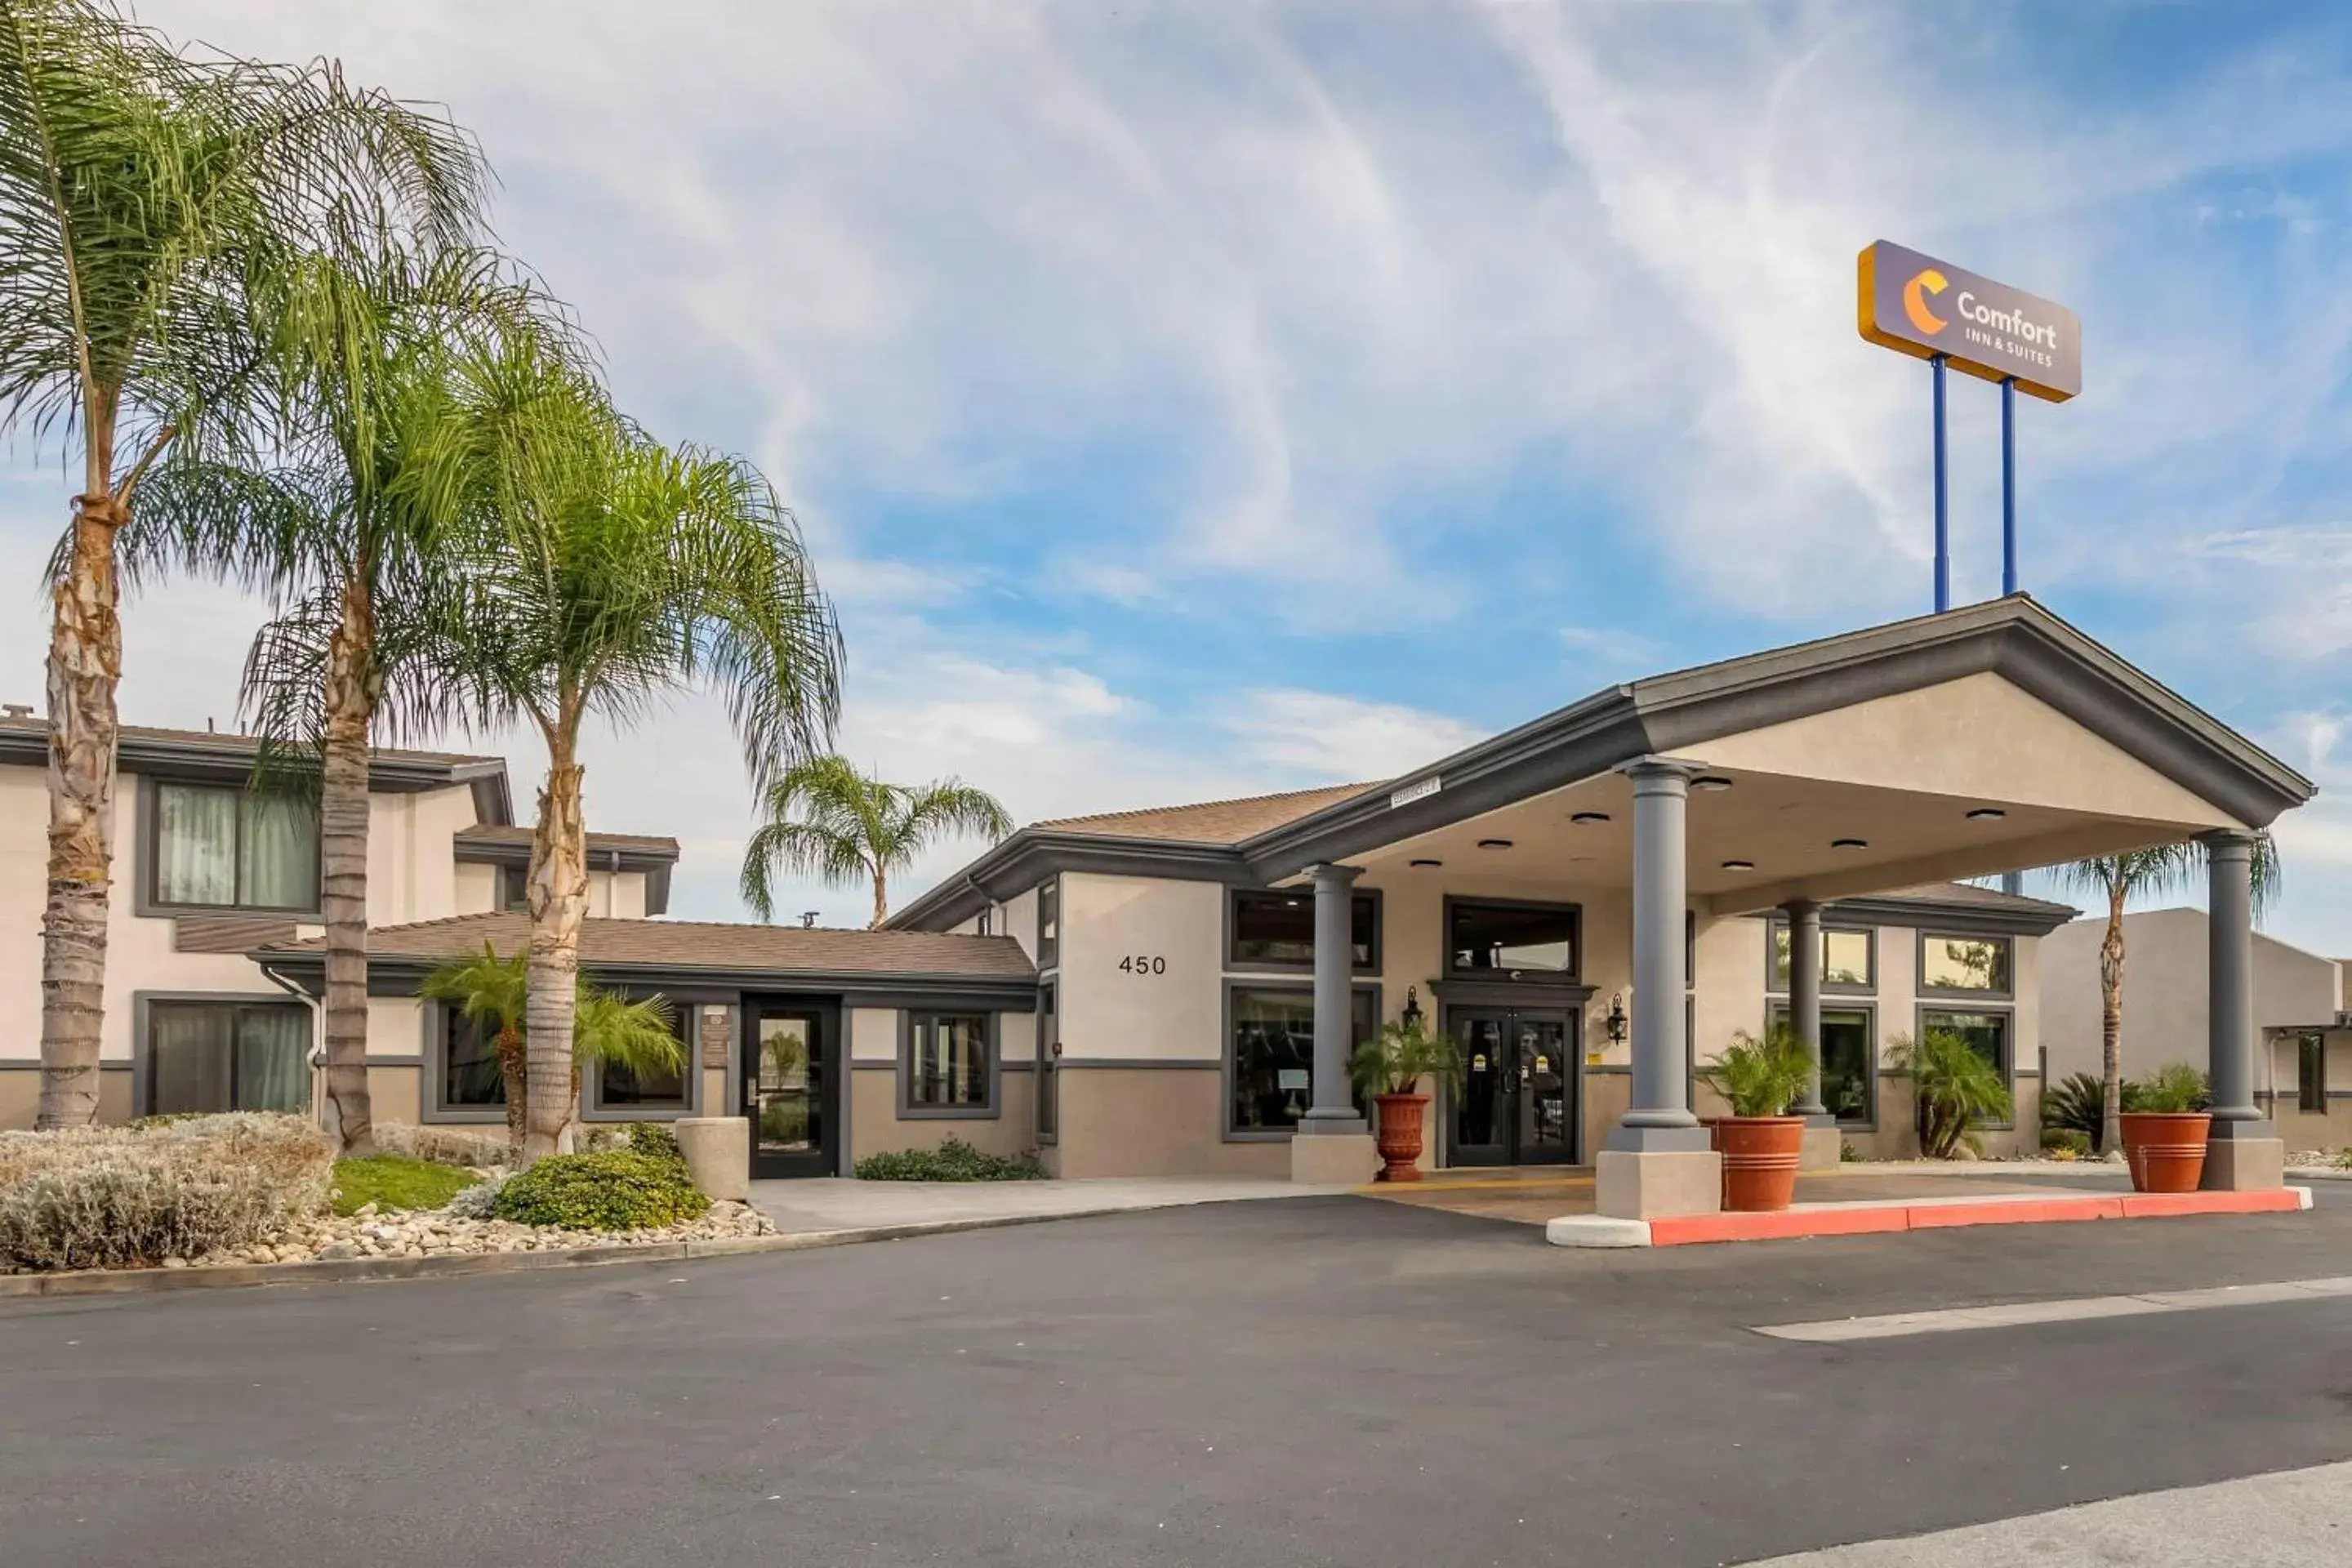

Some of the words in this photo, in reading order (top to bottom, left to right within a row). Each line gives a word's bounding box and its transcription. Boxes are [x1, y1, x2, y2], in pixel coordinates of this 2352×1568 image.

[1958, 291, 2057, 350] Comfort
[1966, 327, 1991, 346] INN
[1994, 337, 2003, 351] &
[2007, 341, 2052, 368] SUITES
[1119, 955, 1165, 974] 450
